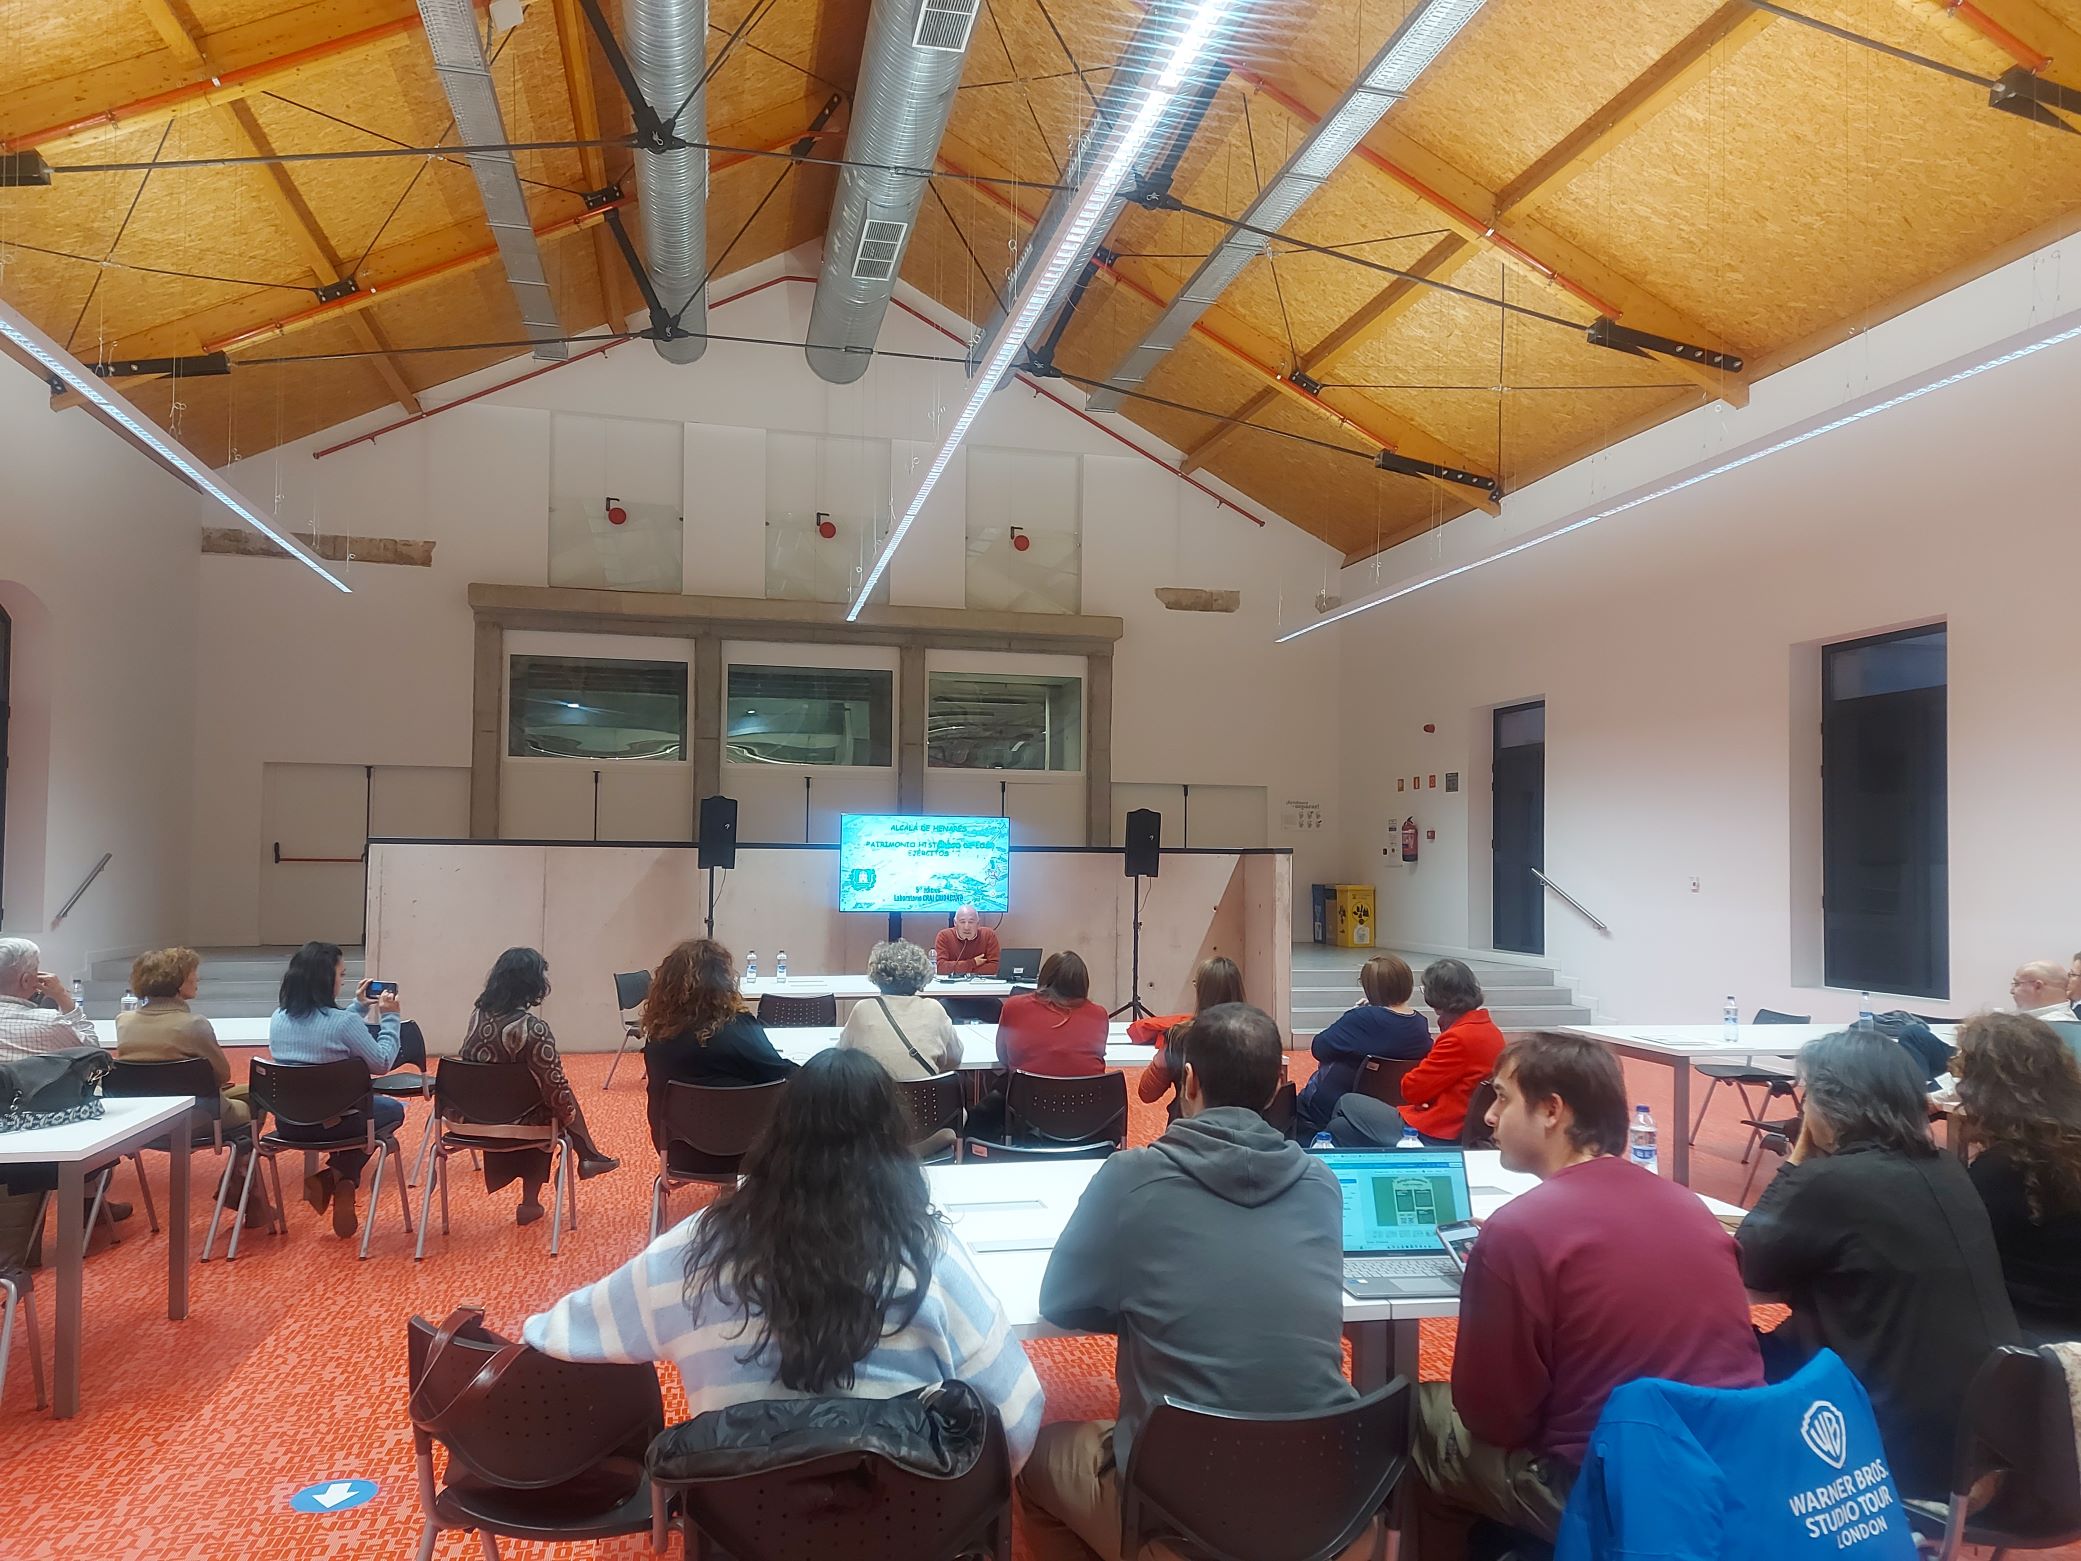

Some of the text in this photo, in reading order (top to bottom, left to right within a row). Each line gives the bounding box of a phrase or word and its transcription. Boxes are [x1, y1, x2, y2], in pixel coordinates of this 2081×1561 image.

[865, 840, 915, 849] PATRIMONIO
[920, 824, 930, 832] DE
[933, 824, 967, 833] HENARES
[1789, 1458, 1889, 1517] WARNER BROS.
[71, 1521, 198, 1544] TOKYO
[215, 1504, 402, 1530] SINGAPORE
[1805, 1485, 1893, 1539] STUDIO TOUR
[197, 1532, 332, 1555] BEIJING
[1837, 1515, 1888, 1550] LONDON
